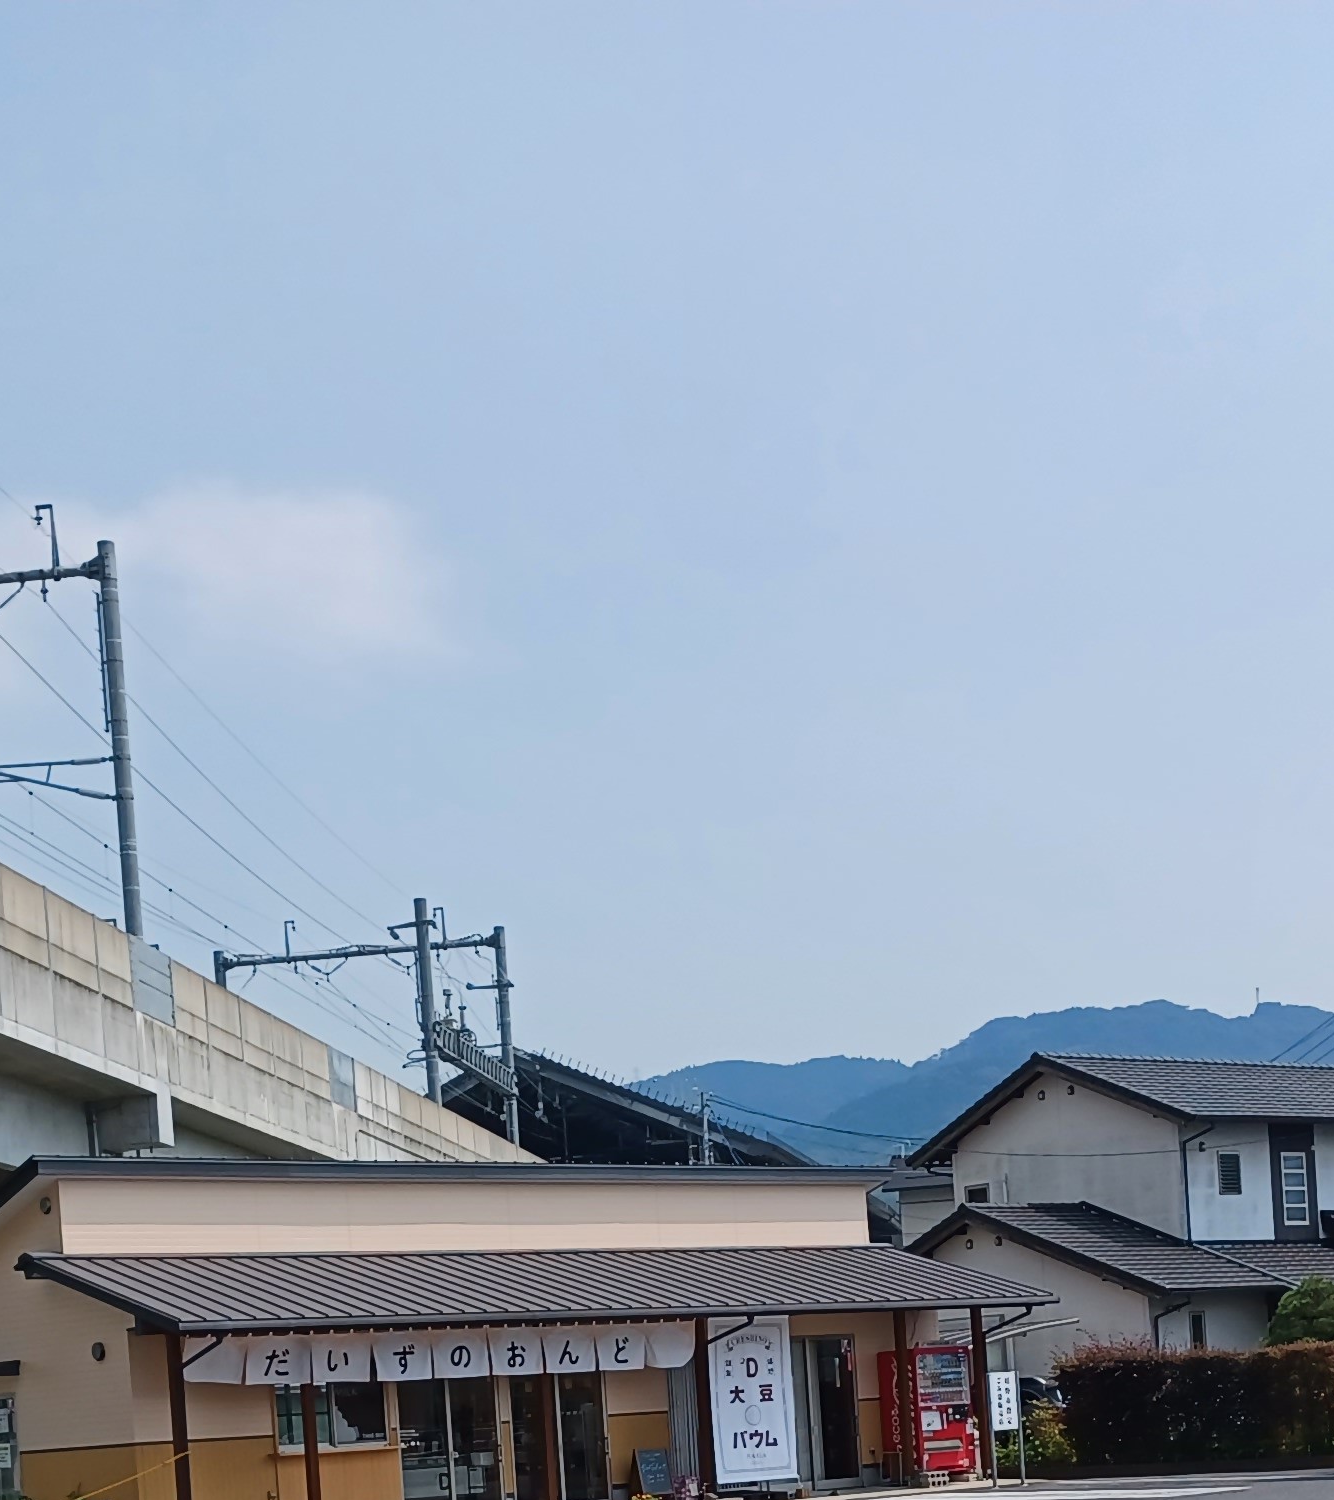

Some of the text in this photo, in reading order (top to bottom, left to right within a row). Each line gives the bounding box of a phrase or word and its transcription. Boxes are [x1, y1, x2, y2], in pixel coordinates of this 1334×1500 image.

[264, 1336, 629, 1377] だいずのおんど
[733, 1429, 779, 1449] バウム
